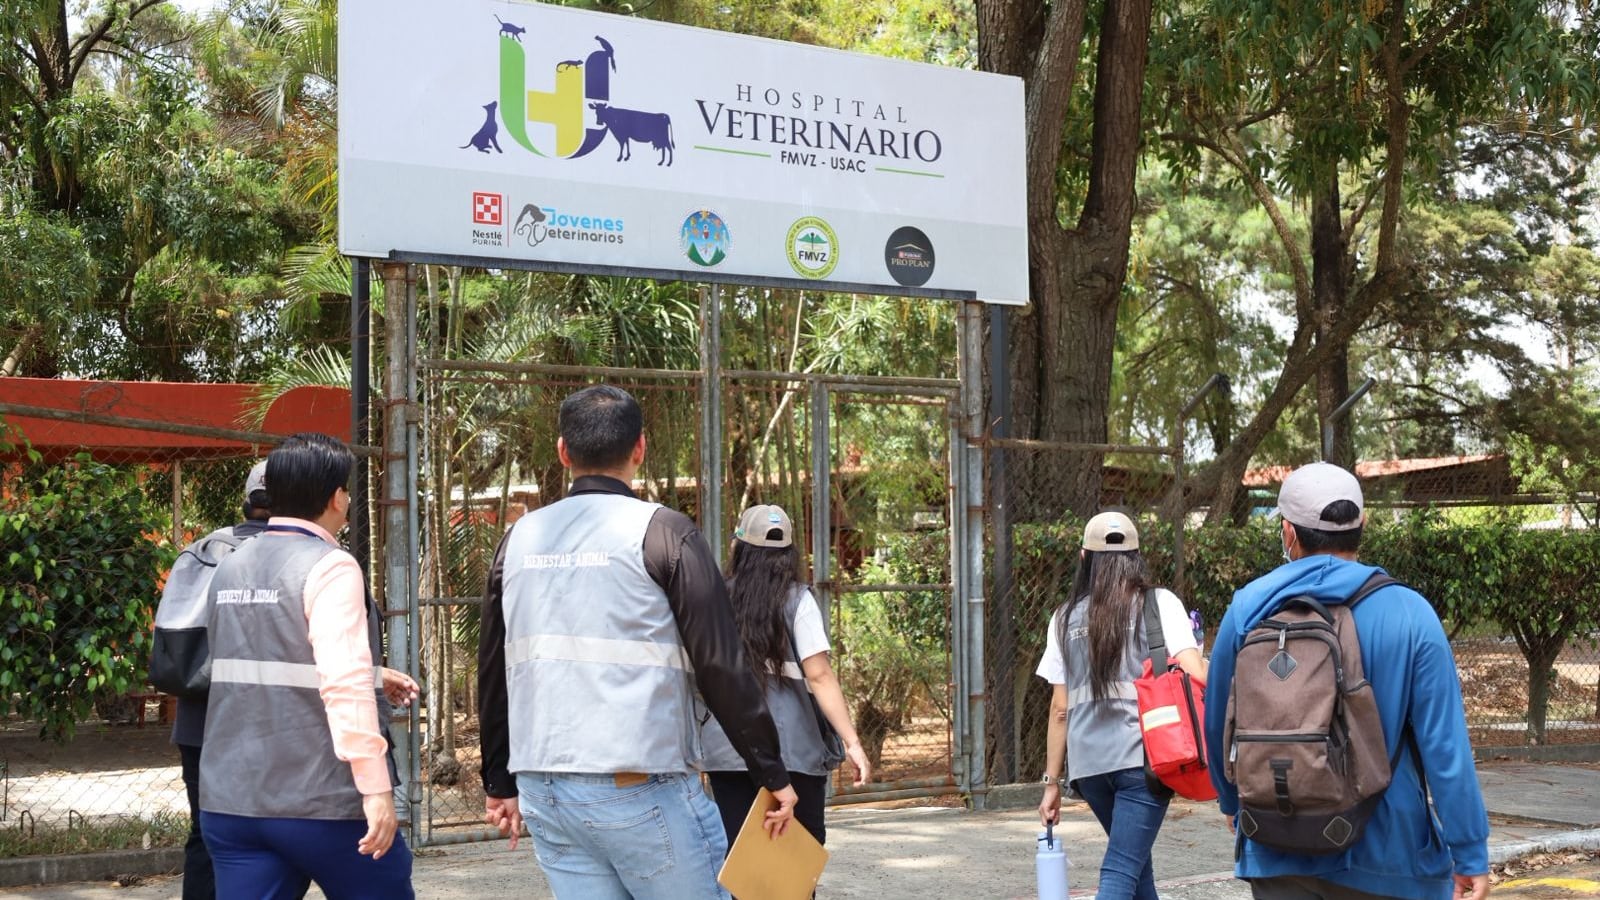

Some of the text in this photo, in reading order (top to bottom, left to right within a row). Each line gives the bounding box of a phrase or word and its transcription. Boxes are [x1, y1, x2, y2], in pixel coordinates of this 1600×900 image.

[736, 83, 907, 123] HOSPITAL
[695, 98, 942, 163] VETERINARIO
[780, 150, 817, 168] FMVZ
[831, 157, 867, 173] USAC
[472, 229, 503, 240] Nestlé
[472, 239, 503, 247] PURINA
[798, 250, 828, 263] FMVZ
[891, 257, 930, 268] PRO PLAN
[522, 553, 571, 569] BIENESTAR
